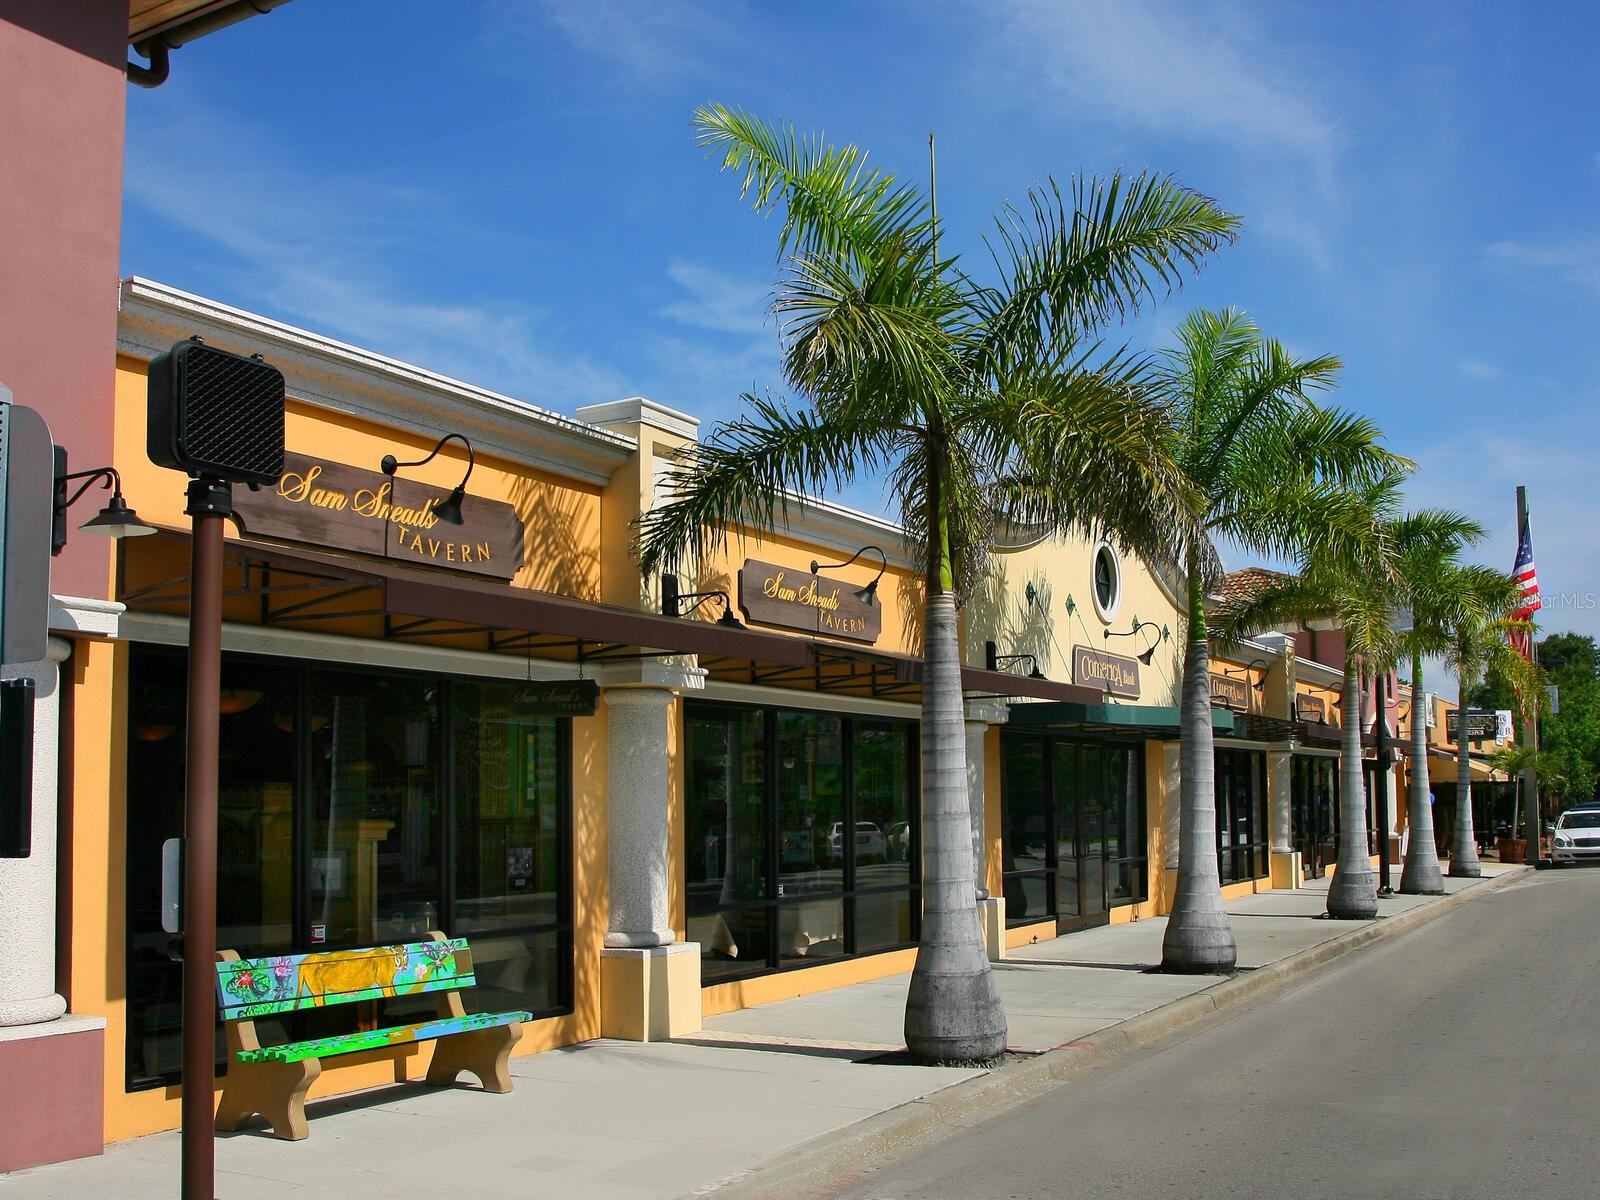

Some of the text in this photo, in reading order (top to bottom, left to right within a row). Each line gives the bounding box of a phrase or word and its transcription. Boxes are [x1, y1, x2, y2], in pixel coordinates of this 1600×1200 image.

[276, 465, 439, 529] Sam Snead's
[398, 525, 491, 563] TAVERN
[762, 571, 841, 611] Sam Snead's
[818, 609, 866, 632] TAVERN
